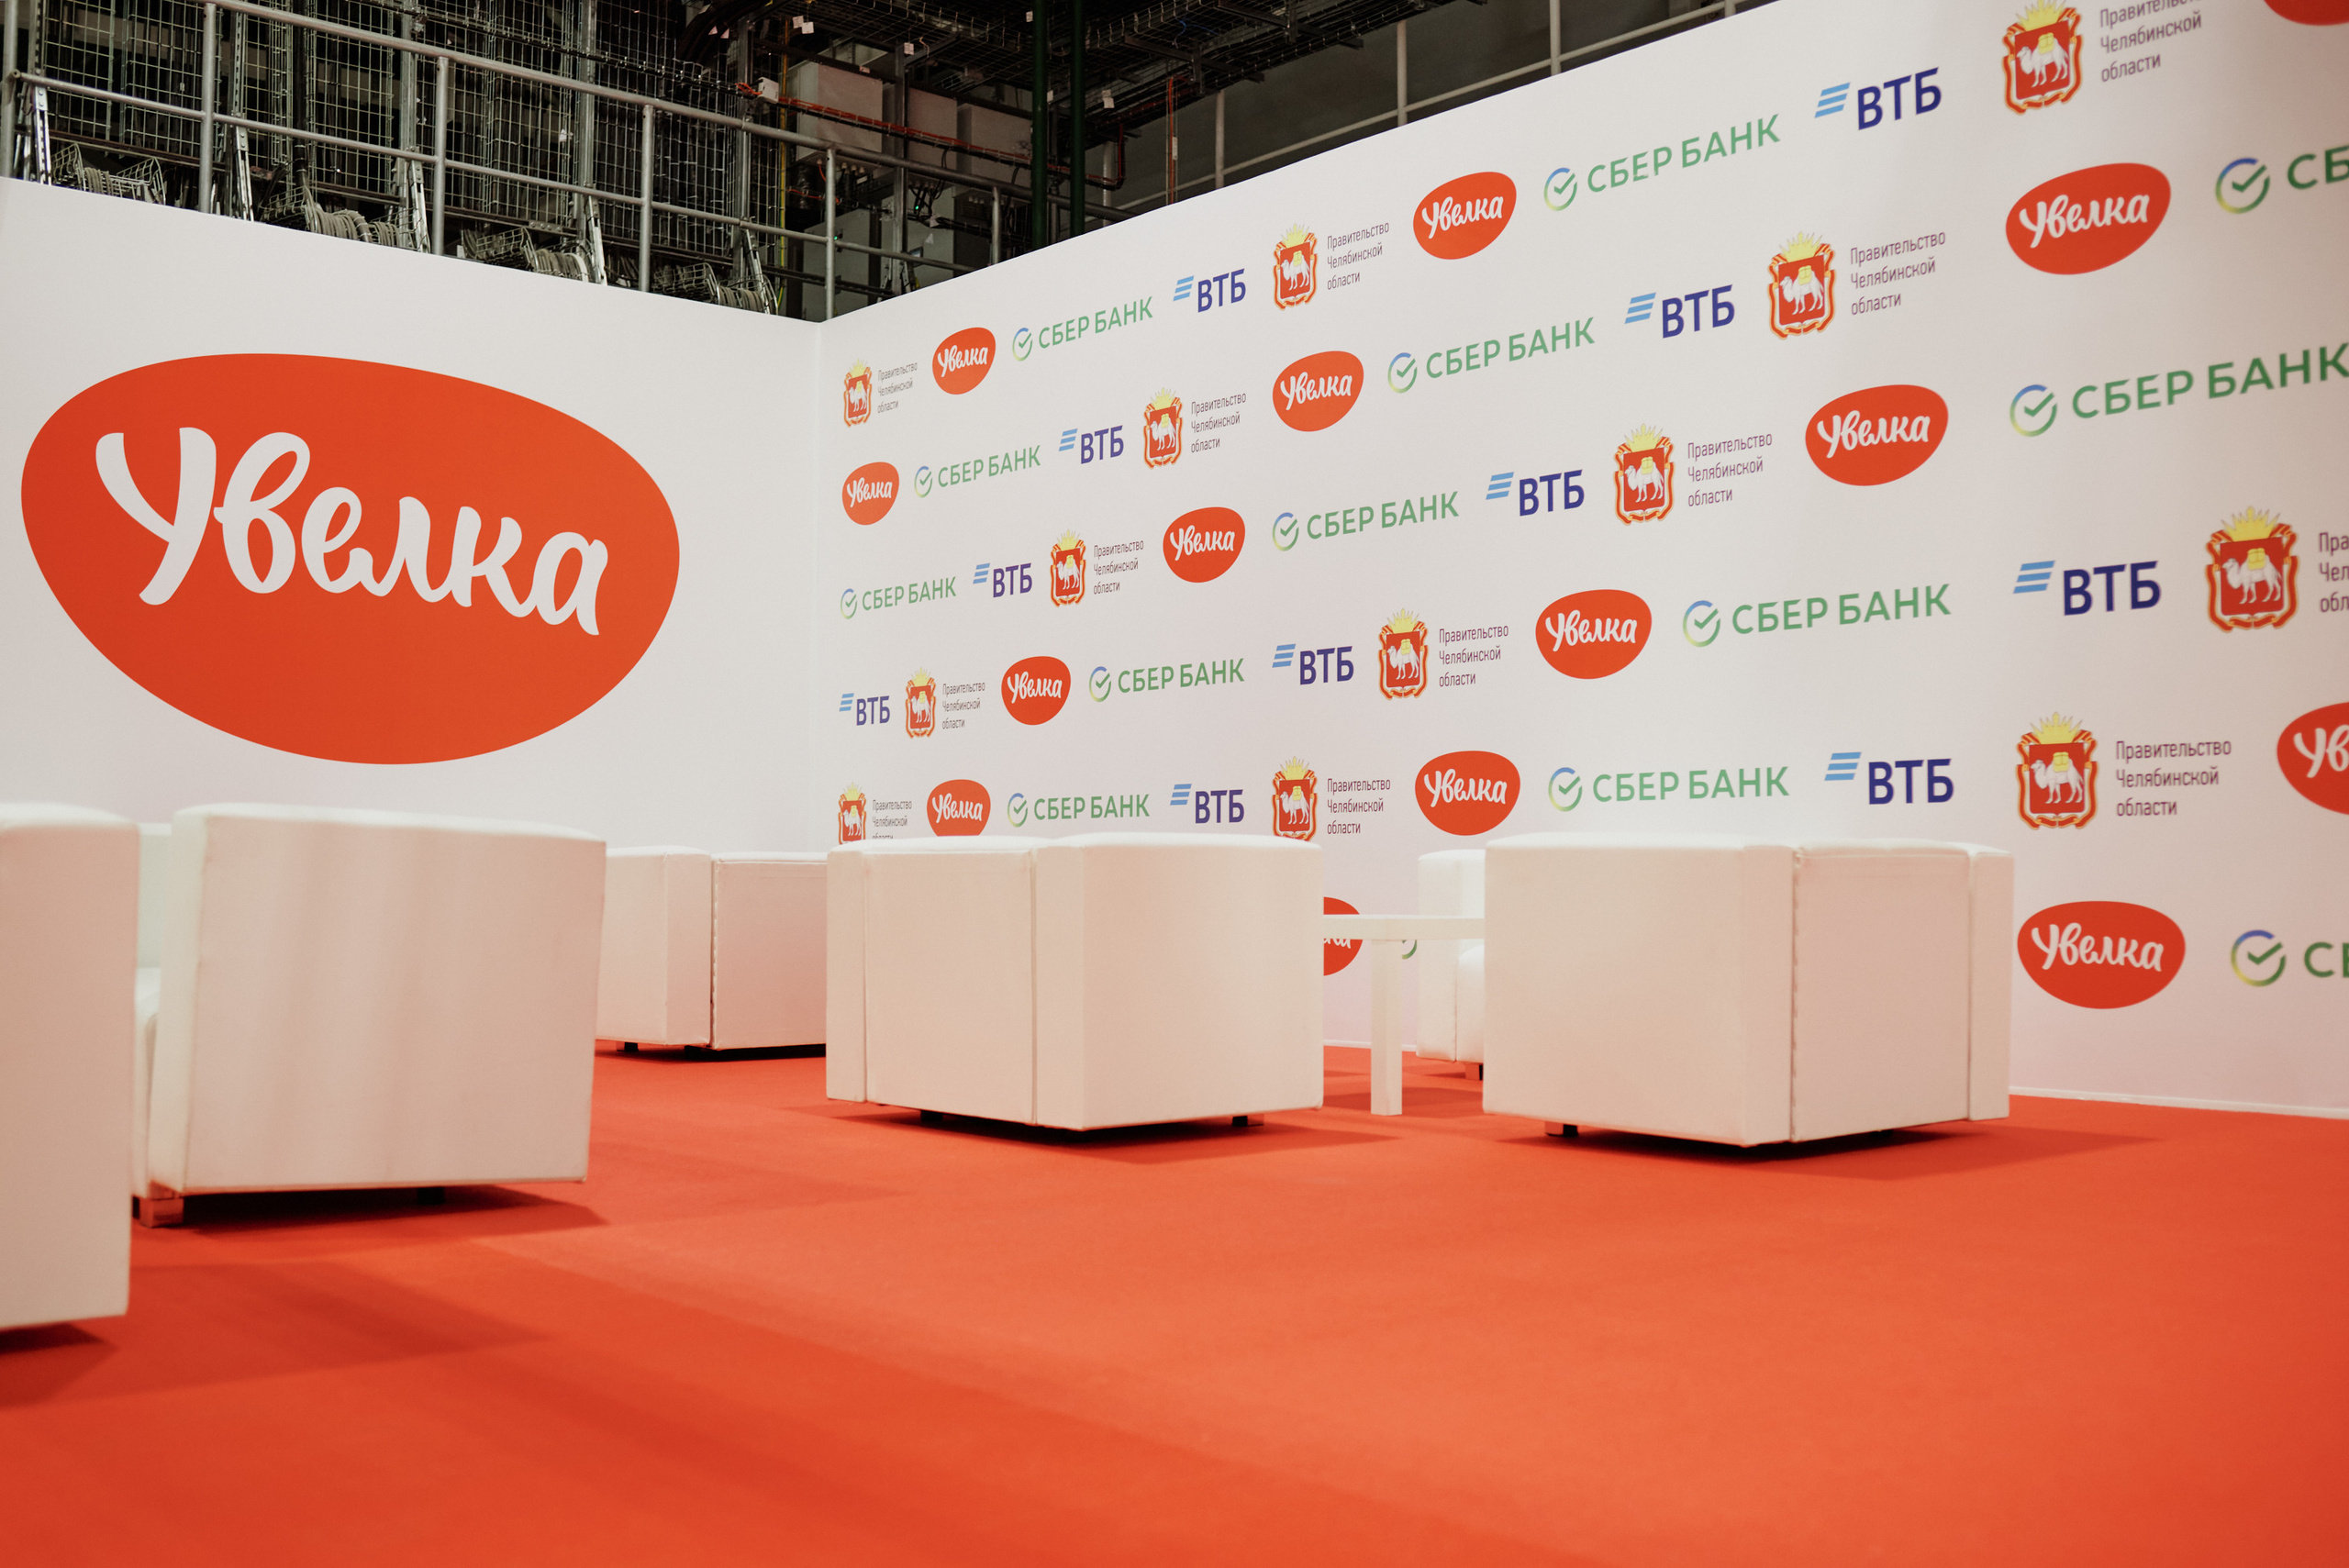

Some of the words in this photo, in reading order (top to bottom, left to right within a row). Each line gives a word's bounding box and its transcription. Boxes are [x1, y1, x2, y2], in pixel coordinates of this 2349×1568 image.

[2100, 9, 2201, 52] Челябинской
[2101, 54, 2161, 82] области
[1858, 67, 1942, 130] ВТБ
[1587, 147, 1672, 192] СБЕР
[1682, 114, 1780, 168] БАНК
[1422, 193, 1503, 239] Увелка
[2020, 192, 2150, 248] Увелка
[1328, 222, 1389, 252] Правительство
[1851, 231, 1945, 267] Правительство
[1328, 241, 1382, 269] Челябинской
[1851, 254, 1935, 288] Челябинской
[1198, 269, 1246, 312] ВТБ
[1328, 272, 1360, 290] области
[1663, 284, 1734, 339] ВТБ
[1852, 293, 1901, 315] области
[1039, 316, 1089, 349] СБЕР
[1096, 296, 1152, 333] БАНК
[938, 344, 988, 377] Увелка
[1427, 339, 1500, 378] СБЕР
[1509, 317, 1595, 361] БАНК
[1281, 371, 1353, 411] Увелка
[2073, 371, 2194, 418] СБЕР
[2209, 342, 2349, 398] БАНК
[1191, 409, 1240, 433] Челябинской
[1192, 394, 1246, 417] Правительство
[1081, 426, 1123, 464] ВТБ
[1191, 437, 1219, 452] области
[1688, 432, 1772, 462] Правительство
[1817, 410, 1931, 458] Увелка
[939, 460, 984, 487] СБЕР
[989, 445, 1041, 476] БАНК
[1688, 454, 1763, 482] Челябинской
[847, 478, 892, 507] Увелка
[1520, 470, 1584, 516] ВТБ
[1688, 487, 1732, 506] области
[95, 427, 609, 636] Увелка
[1308, 506, 1374, 539] СБЕР
[1382, 491, 1459, 528] БАНК
[1094, 539, 1143, 560] Правительство
[1170, 526, 1234, 562] Увелка
[993, 563, 1032, 597] ВТБ
[1094, 558, 1138, 575] Челябинской
[863, 586, 904, 610] СБЕР
[909, 576, 956, 604] БАНК
[1094, 580, 1119, 595] области
[2064, 561, 2161, 616] ВТБ
[1732, 597, 1828, 634] СБЕР
[1840, 584, 1951, 625] БАНК
[1440, 624, 1508, 647] Правительство
[1545, 609, 1637, 651] Увелка
[1300, 646, 1353, 684] ВТБ
[1440, 646, 1500, 664] Челябинской
[942, 681, 985, 696] Правительство
[1008, 670, 1063, 705] Увелка
[1119, 666, 1174, 693] СБЕР
[1180, 658, 1244, 687] БАНК
[1440, 670, 1475, 687] области
[857, 695, 890, 726] ВТБ
[942, 698, 980, 712] Челябинской
[942, 717, 964, 729] области
[2117, 740, 2232, 763] Правительство
[1328, 778, 1390, 795] Правительство
[1424, 769, 1508, 808] Увелка
[1593, 772, 1679, 802] СБЕР
[1689, 766, 1789, 799] БАНК
[1869, 759, 1954, 805] ВТБ
[2117, 766, 2219, 787] Челябинской
[931, 793, 984, 825] Увелка
[1034, 797, 1085, 820] СБЕР
[1091, 795, 1150, 818] БАНК
[1196, 789, 1244, 823] ВТБ
[1328, 797, 1383, 813] Челябинской
[2117, 797, 2176, 817] области
[1328, 820, 1360, 834] области
[2032, 922, 2164, 971] Увелка
